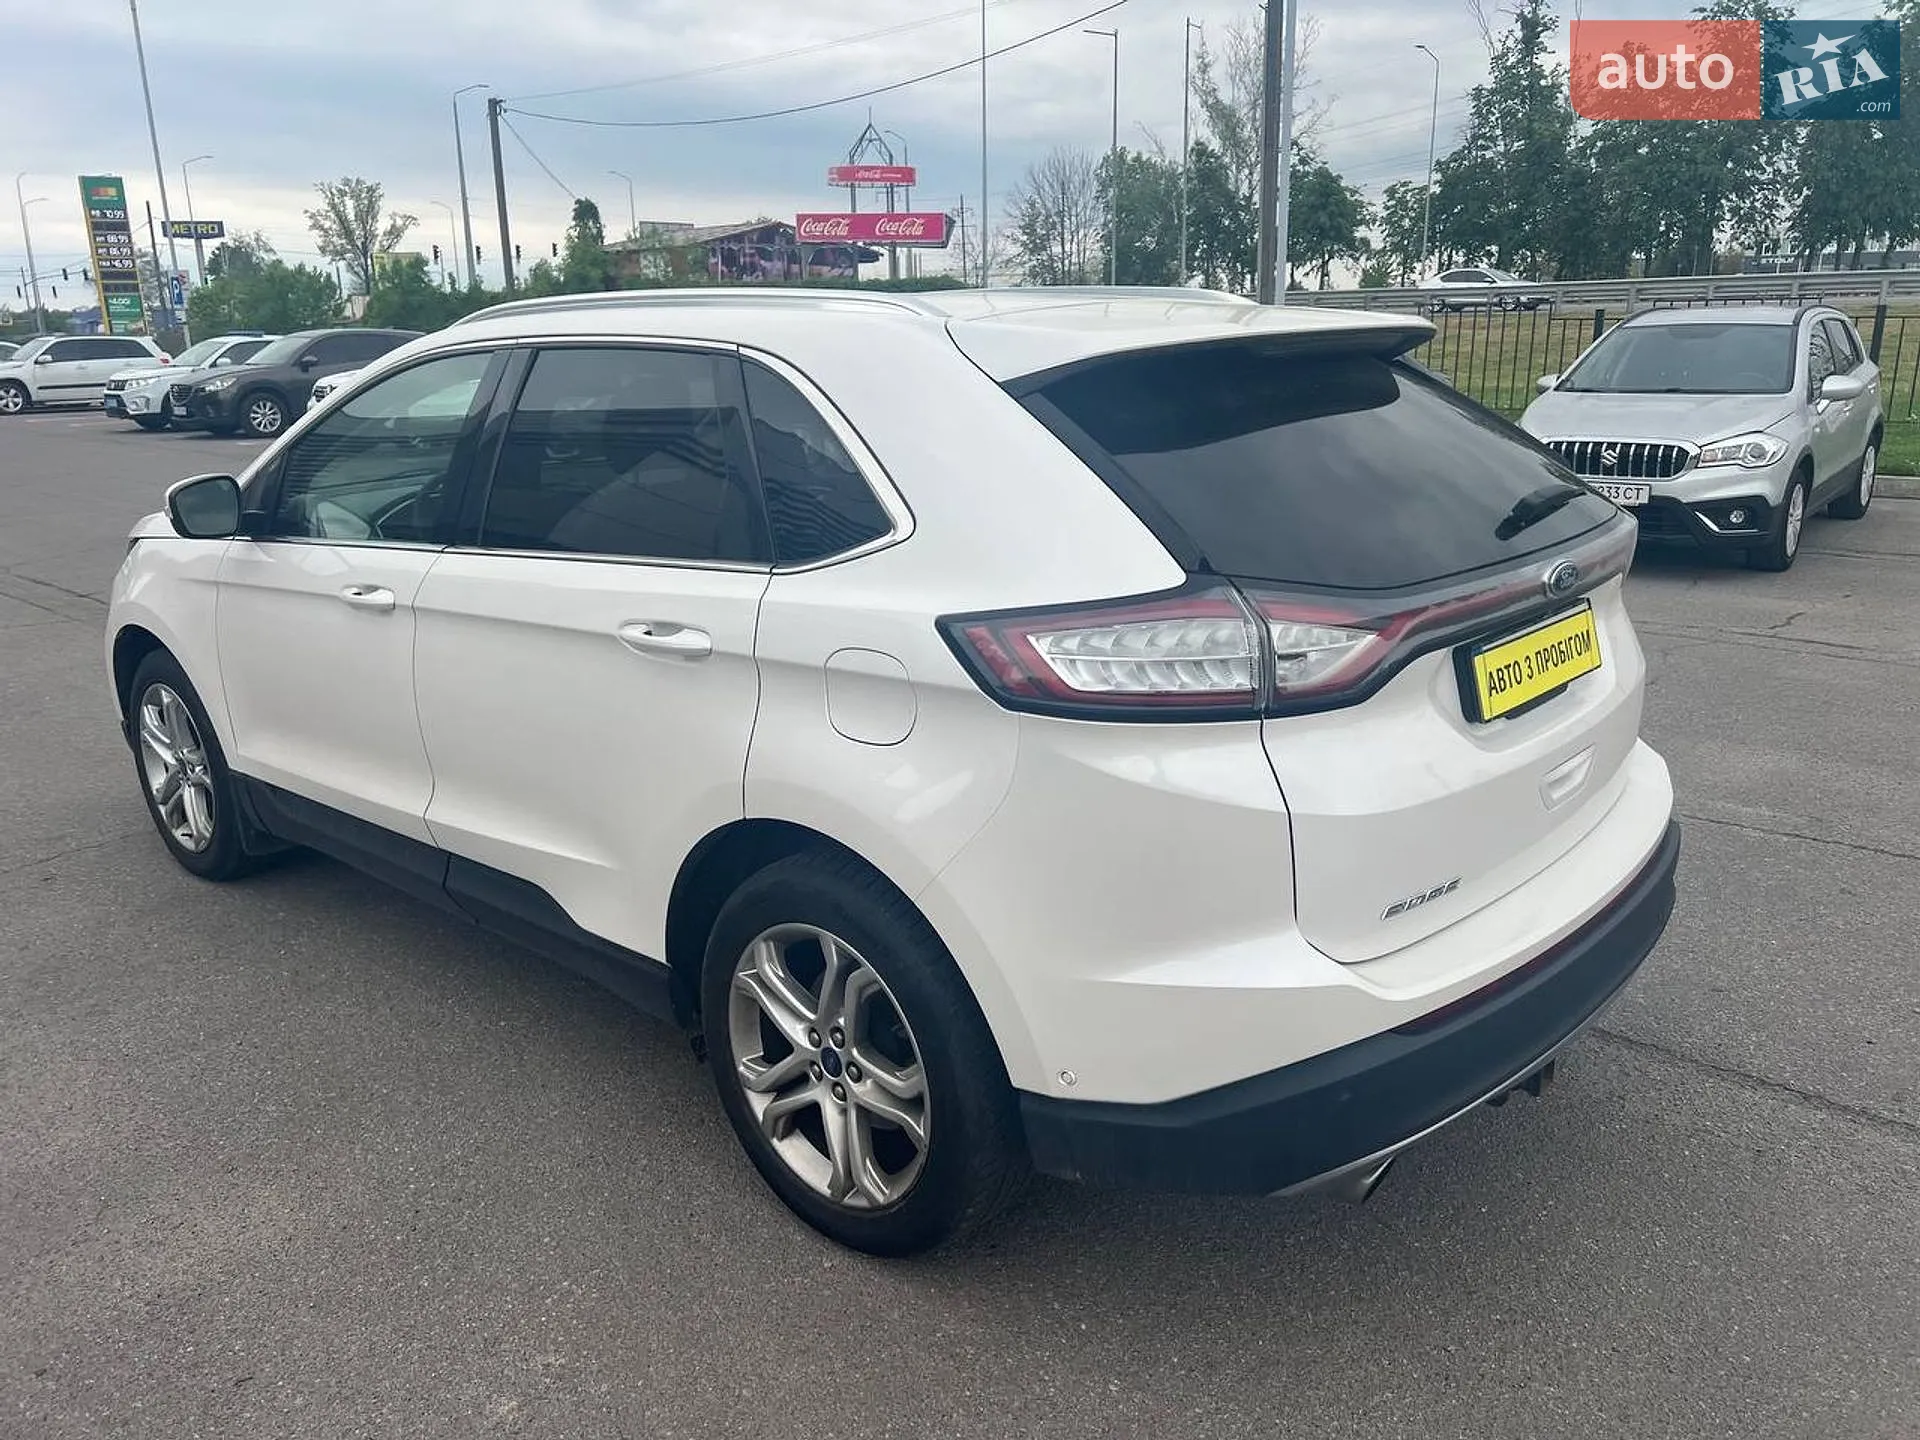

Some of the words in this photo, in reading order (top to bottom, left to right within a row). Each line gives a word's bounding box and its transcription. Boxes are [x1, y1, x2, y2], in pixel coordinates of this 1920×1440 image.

[171, 223, 219, 234] METRO
[1623, 487, 1644, 500] CT
[1487, 660, 1523, 698] АВТО
[1535, 629, 1592, 675] ПРОБІГОМ
[1381, 877, 1462, 920] EDGE
